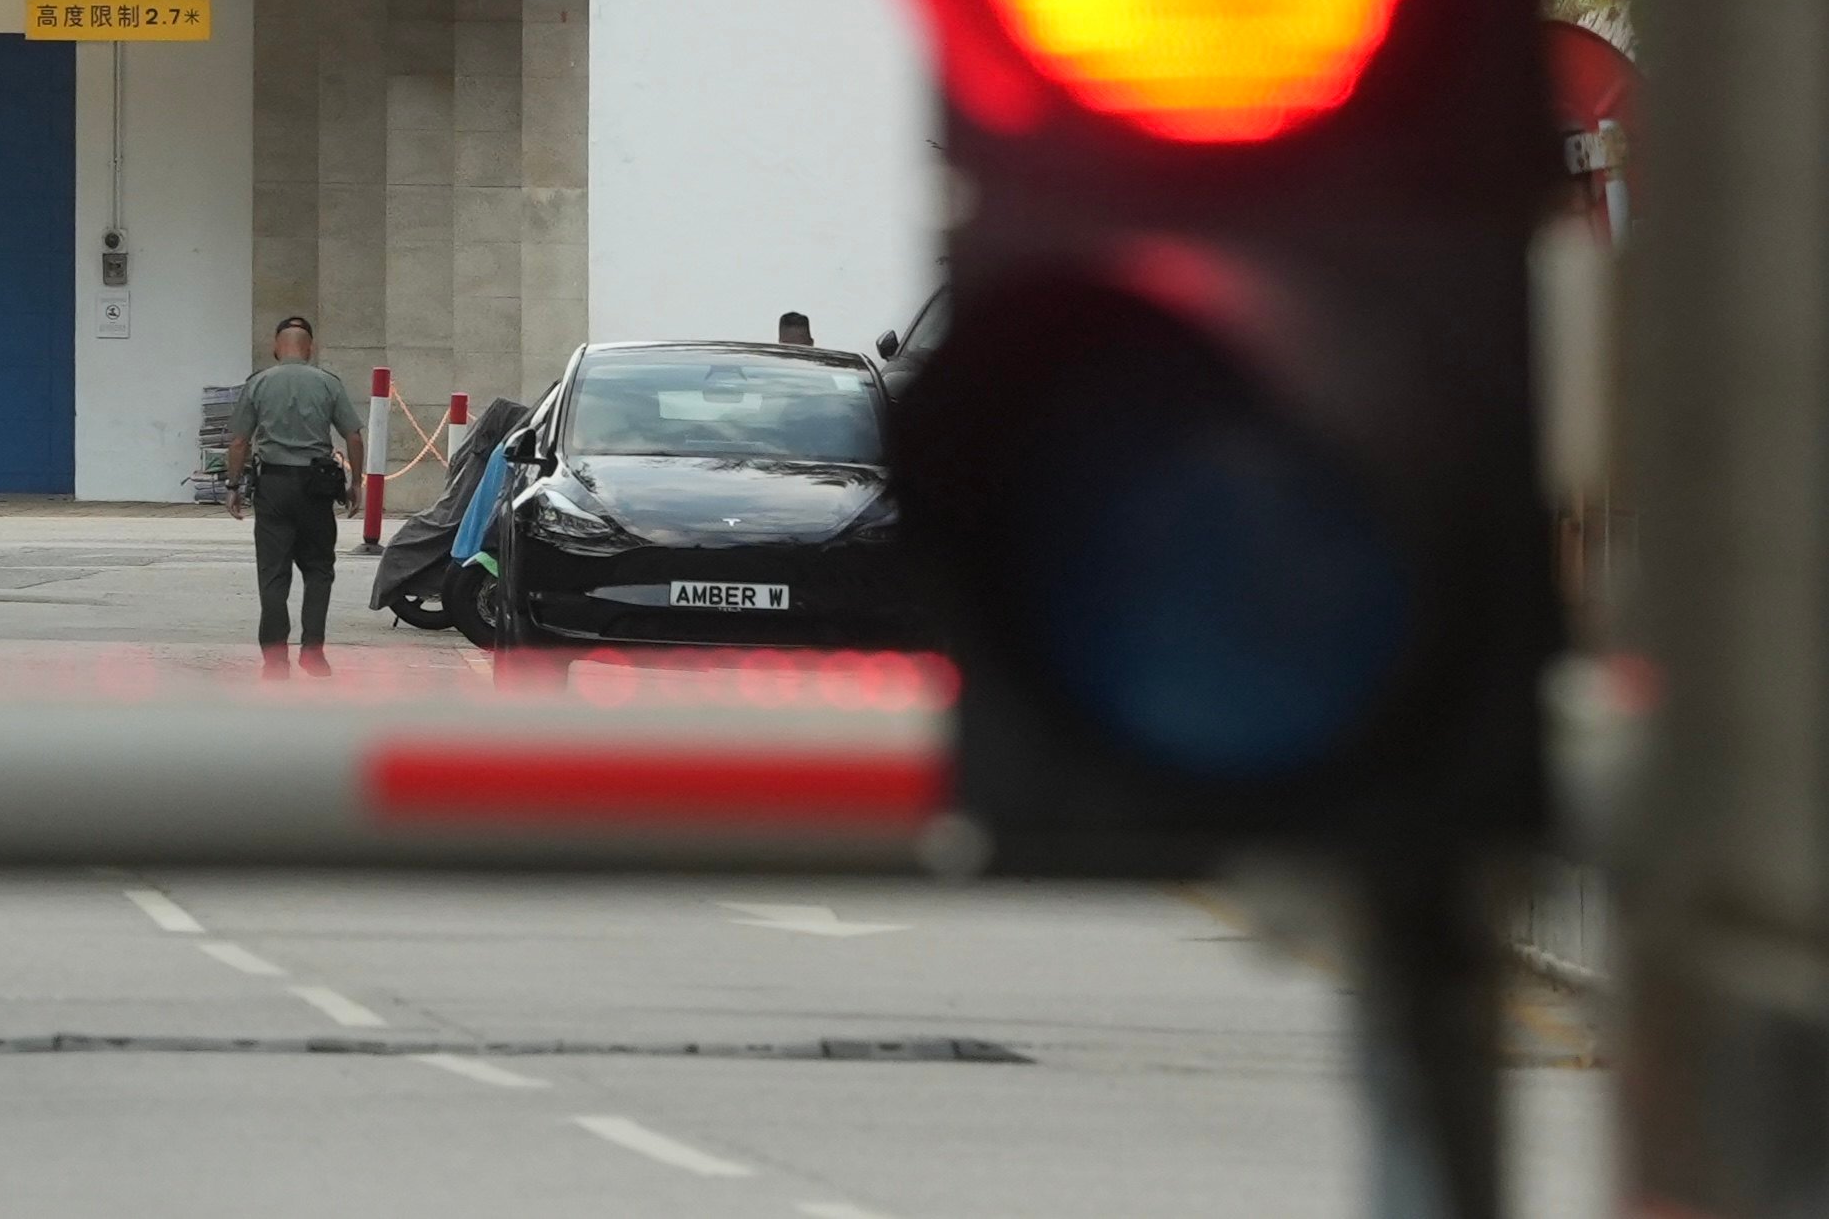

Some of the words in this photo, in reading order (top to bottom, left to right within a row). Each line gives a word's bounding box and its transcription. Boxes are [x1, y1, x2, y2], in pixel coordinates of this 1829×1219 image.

[37, 4, 200, 29] 高度限制2.7米
[675, 584, 756, 607] AMBER
[768, 587, 783, 608] W
